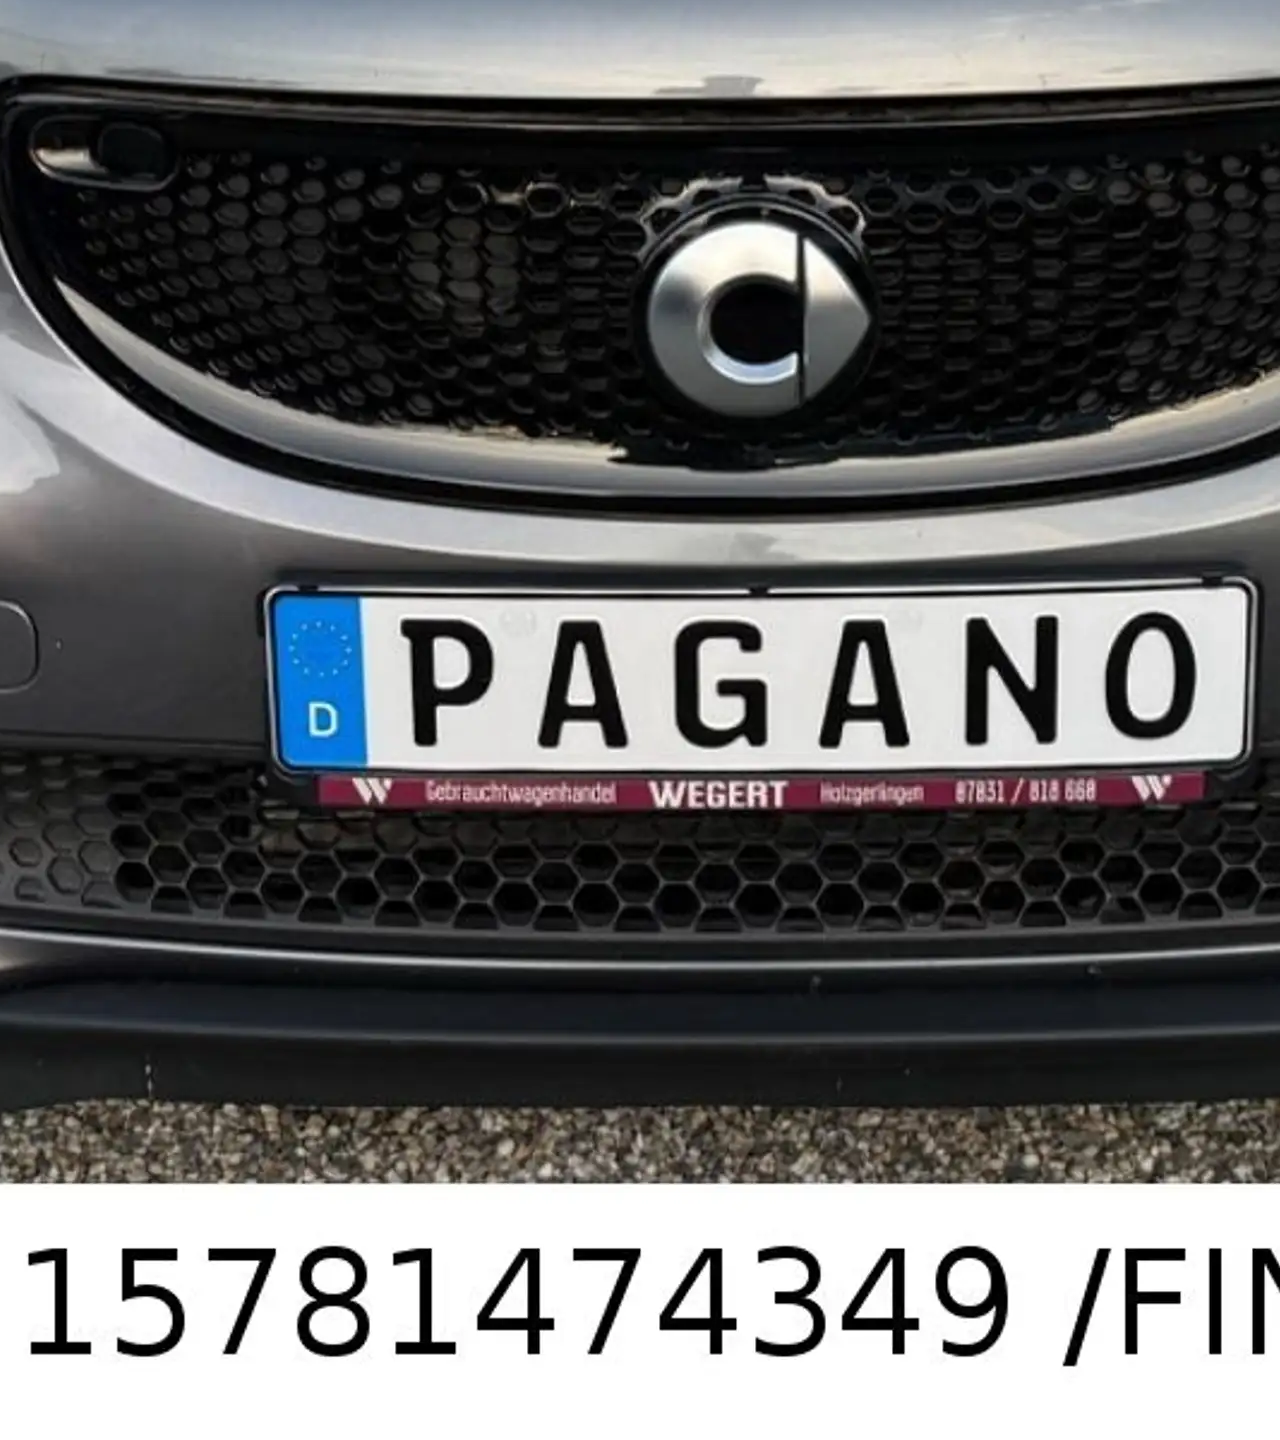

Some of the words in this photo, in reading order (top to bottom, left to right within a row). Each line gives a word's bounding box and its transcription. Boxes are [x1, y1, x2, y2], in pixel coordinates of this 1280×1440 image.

[400, 611, 1196, 749] PAGANO
[309, 703, 337, 736] D
[424, 779, 618, 807] Gebrauchtwagenhandel
[647, 779, 789, 809] WEGERT
